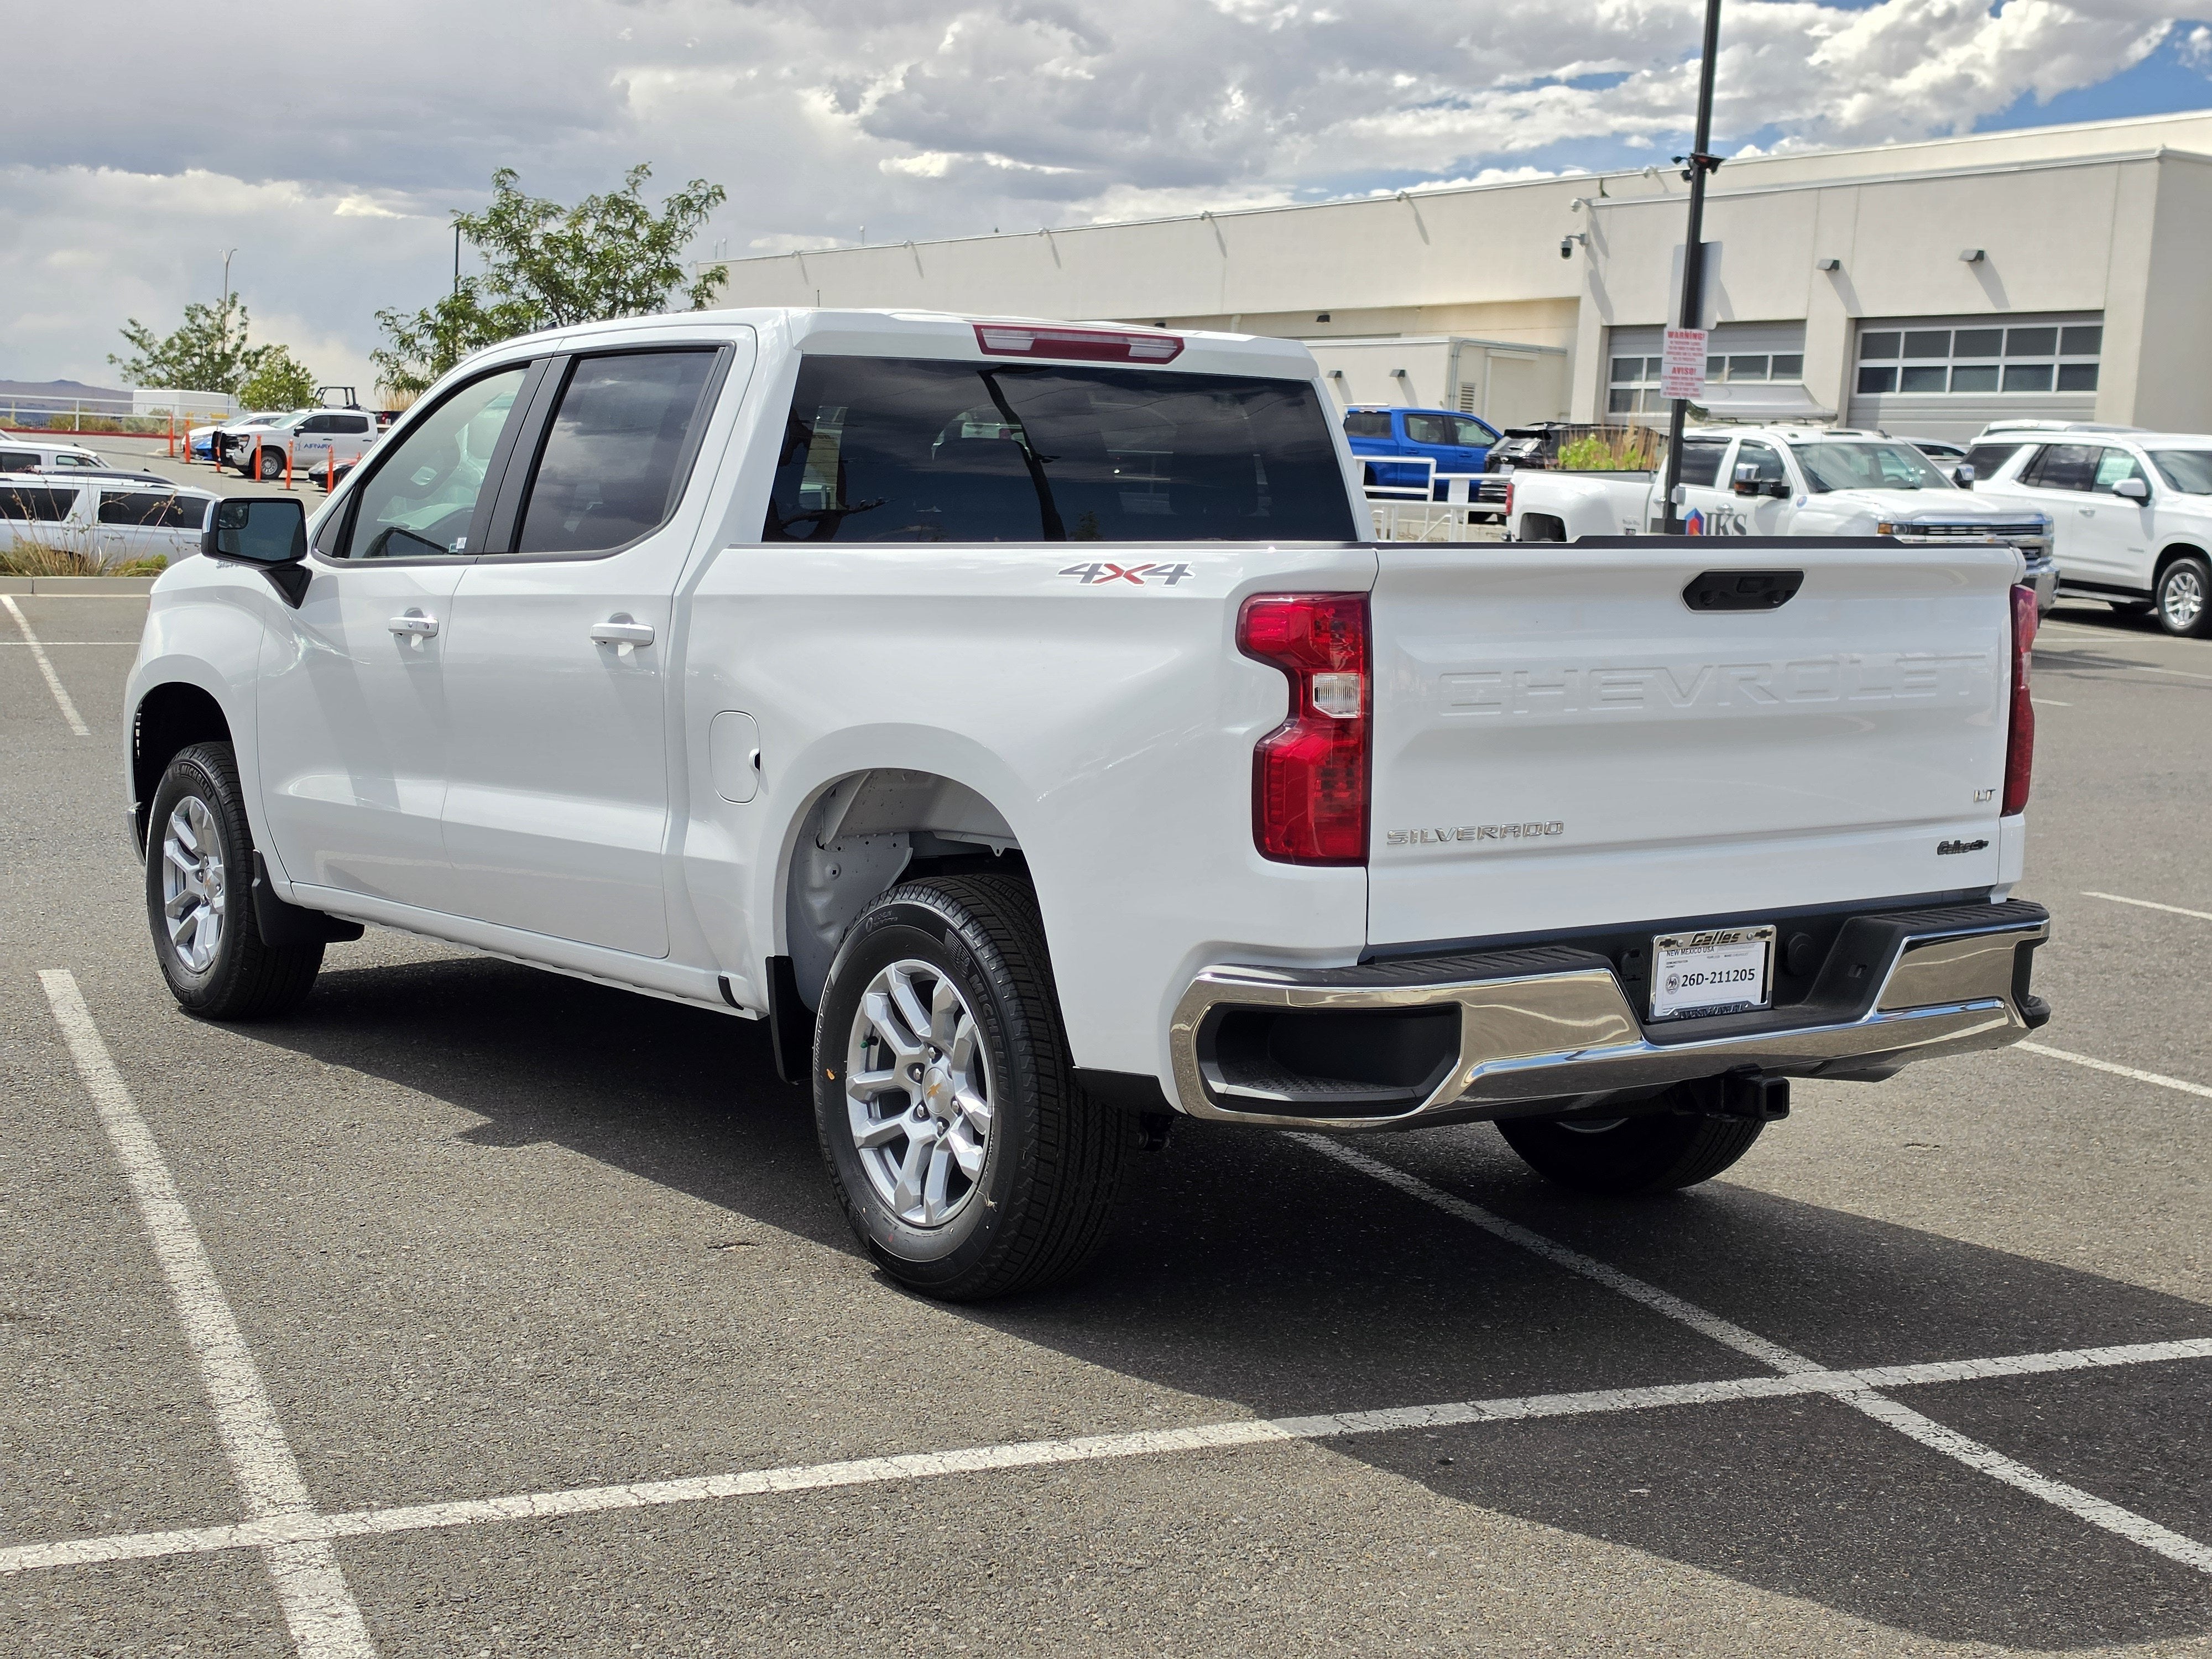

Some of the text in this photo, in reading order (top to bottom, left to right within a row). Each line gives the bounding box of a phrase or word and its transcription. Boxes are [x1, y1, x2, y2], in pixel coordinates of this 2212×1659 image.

[1668, 331, 1705, 340] WARNING!
[1672, 366, 1696, 375] AVISO!
[1438, 655, 1986, 717] CHEVROLET
[181, 764, 212, 798] MICHELIN
[1973, 789, 1996, 802] LT
[1387, 820, 1564, 846] SILVERADO
[1689, 931, 1741, 947] Galles
[1681, 947, 1701, 956] MEXICO
[1681, 968, 1755, 987] 26D-211205
[969, 974, 1009, 1094] MICHELIN
